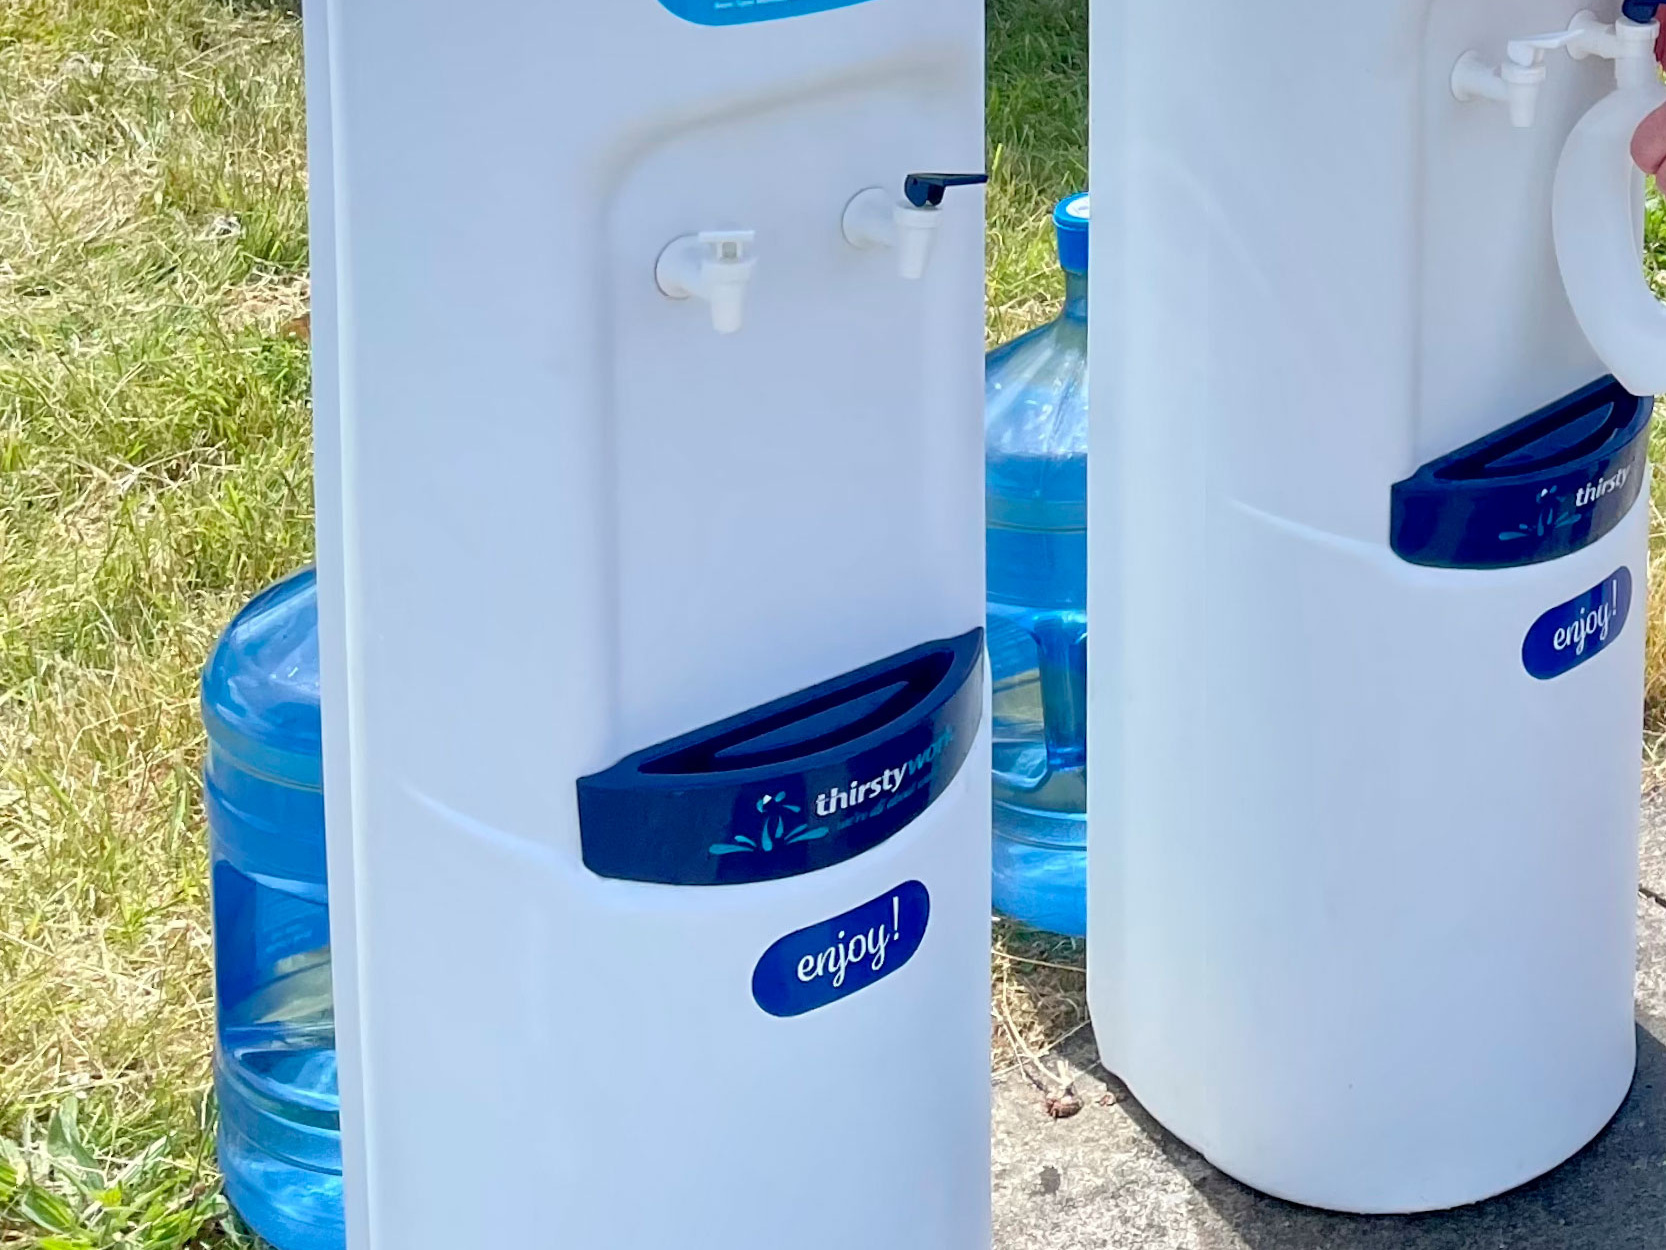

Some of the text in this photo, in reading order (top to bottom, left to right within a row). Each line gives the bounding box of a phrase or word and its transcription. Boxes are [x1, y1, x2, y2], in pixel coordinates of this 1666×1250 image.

[1554, 579, 1617, 655] enjoy!
[816, 724, 953, 816] thirstywork
[797, 896, 900, 987] enjoy!
